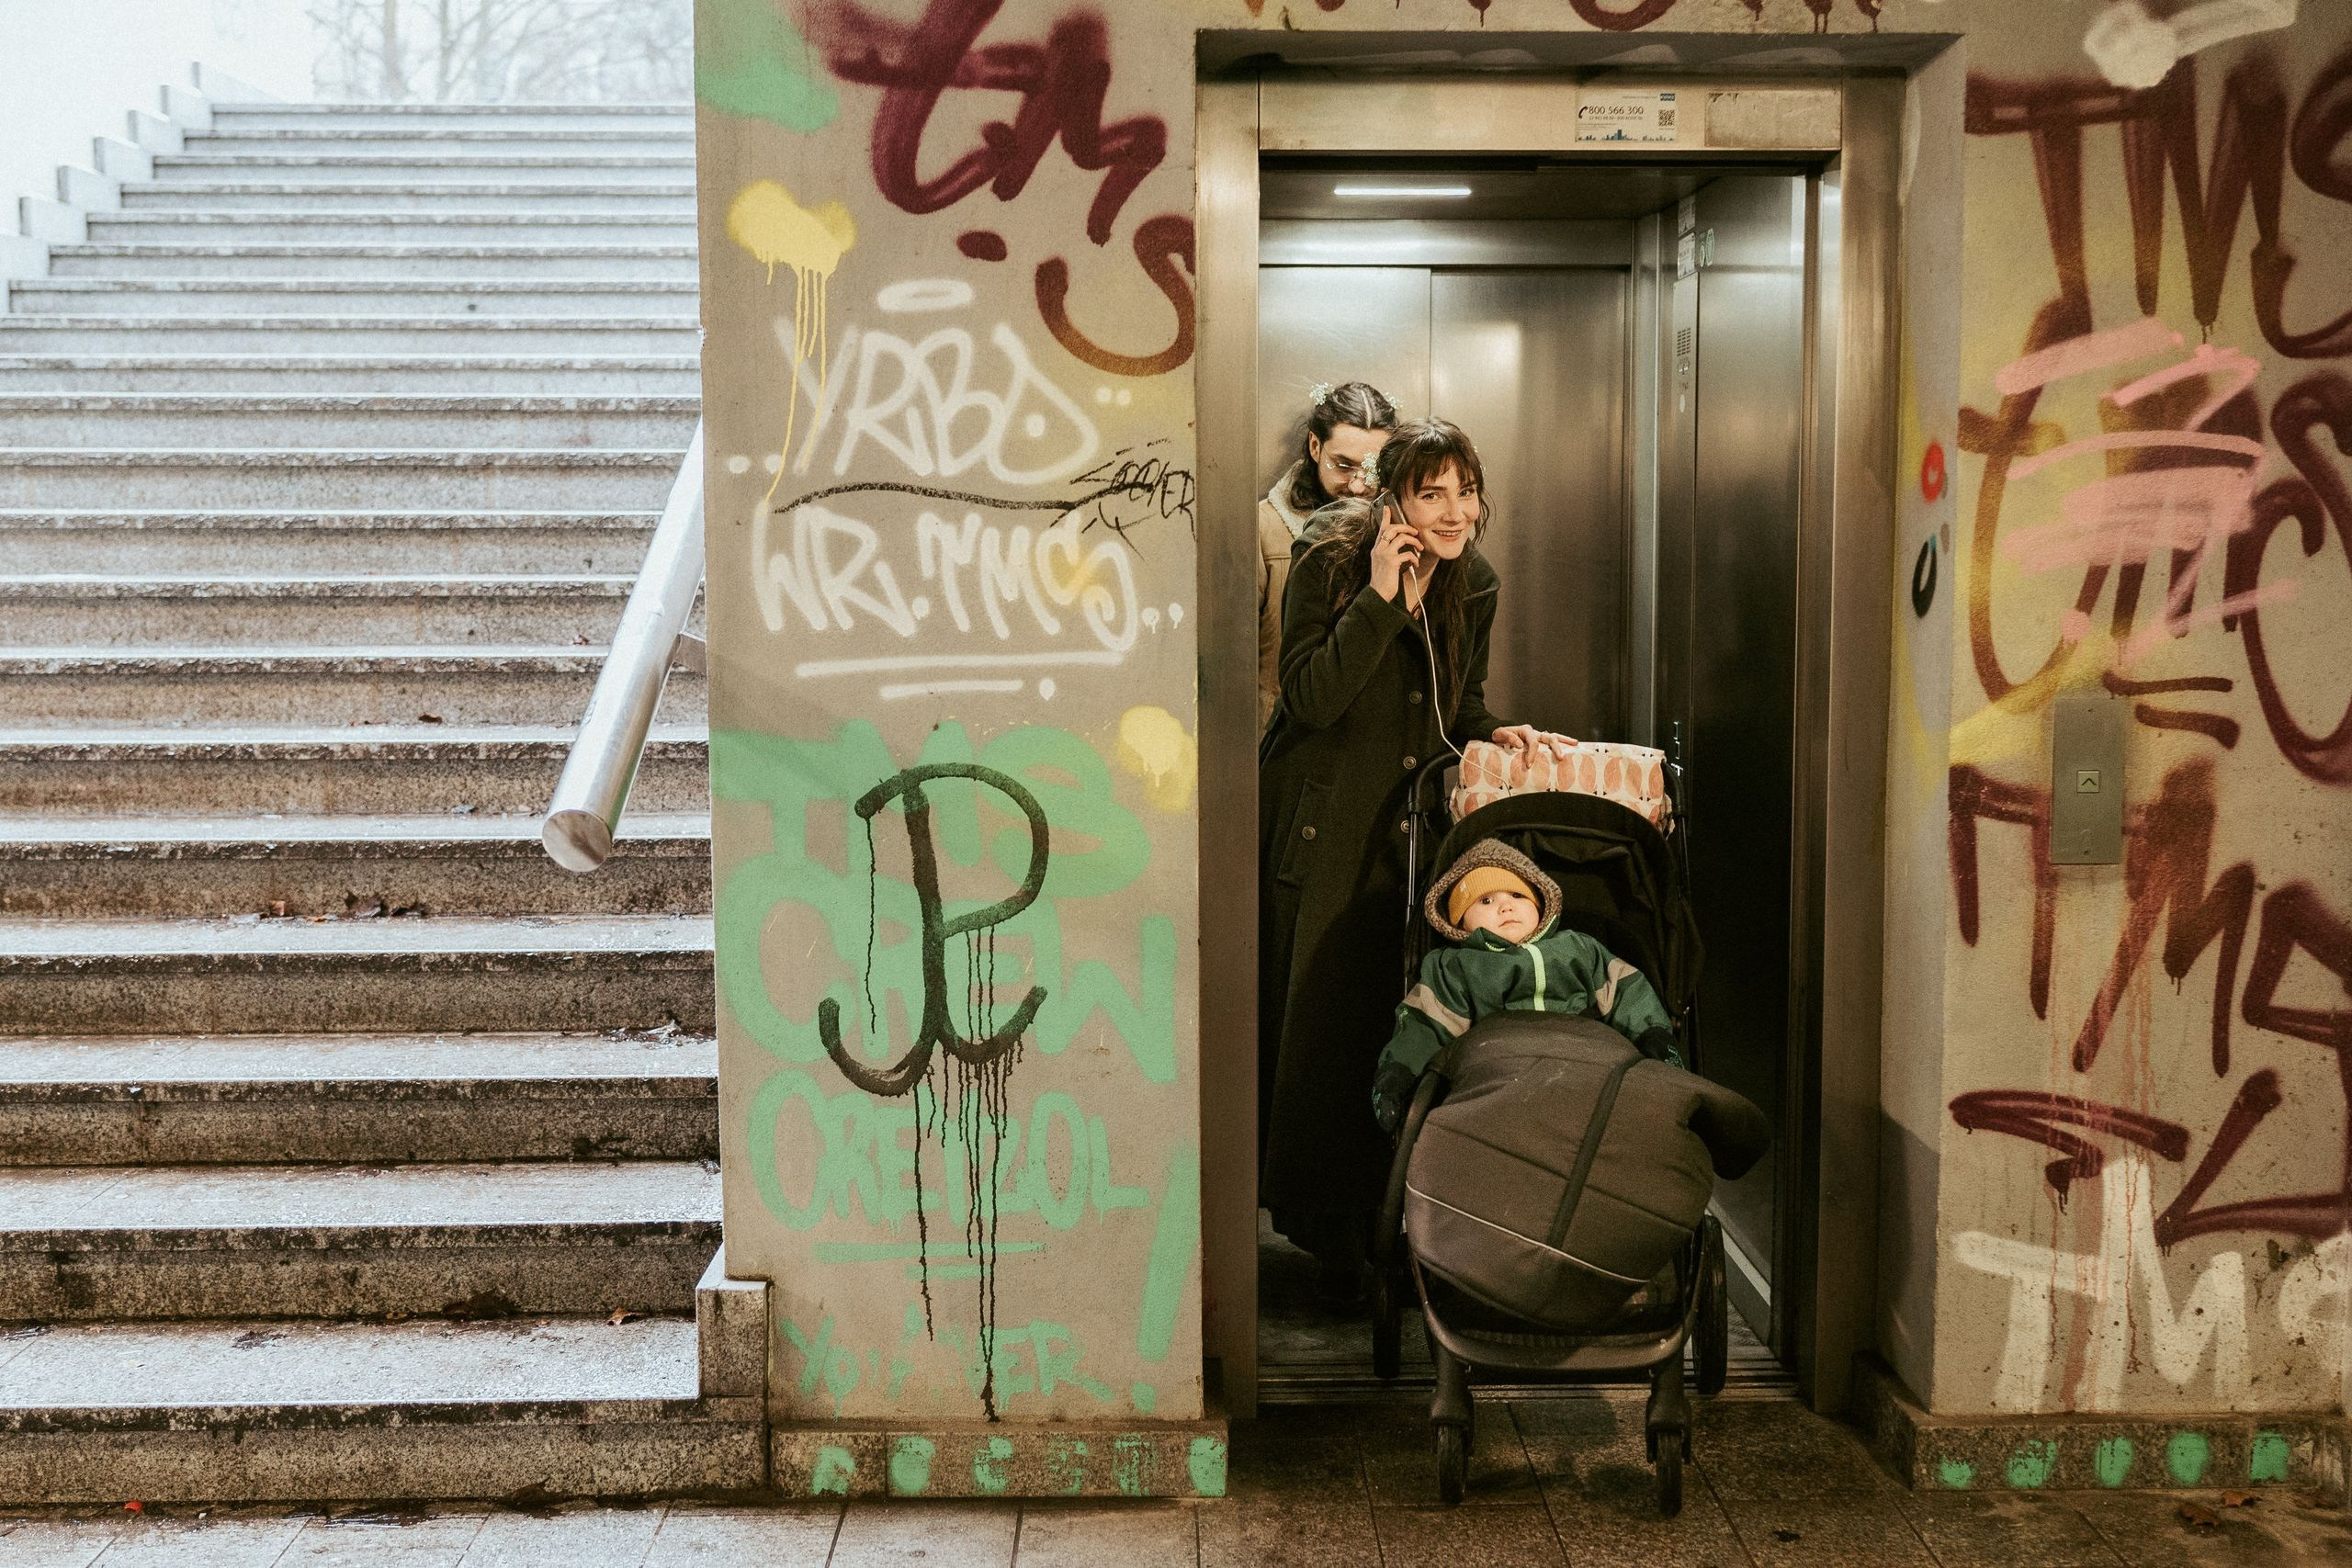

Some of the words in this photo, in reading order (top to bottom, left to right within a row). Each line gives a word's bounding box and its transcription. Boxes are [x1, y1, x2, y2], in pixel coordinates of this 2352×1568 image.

[1589, 106, 1605, 115] 800
[1609, 106, 1624, 115] 566
[1627, 106, 1645, 115] 300
